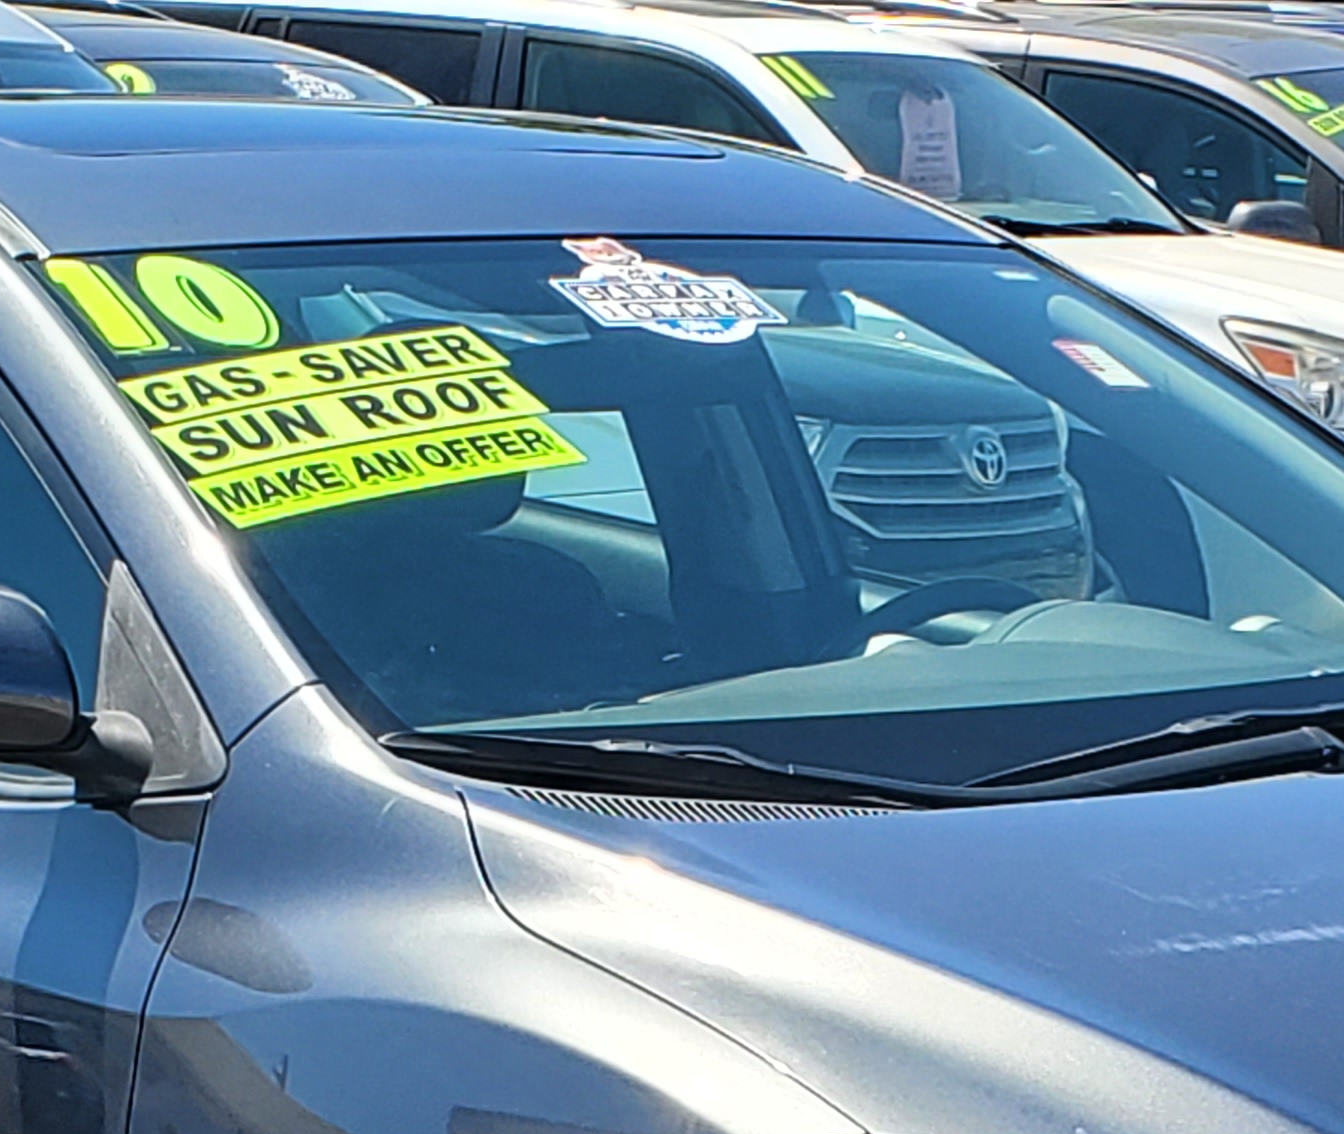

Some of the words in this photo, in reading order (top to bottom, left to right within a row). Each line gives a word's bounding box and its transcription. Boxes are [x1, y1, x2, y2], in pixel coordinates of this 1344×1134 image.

[45, 254, 281, 351] 10
[177, 403, 327, 463] SUN
[340, 375, 520, 430] ROOF
[209, 460, 342, 514] MAKE
[352, 448, 416, 485] AN
[417, 429, 553, 469] OFFER
